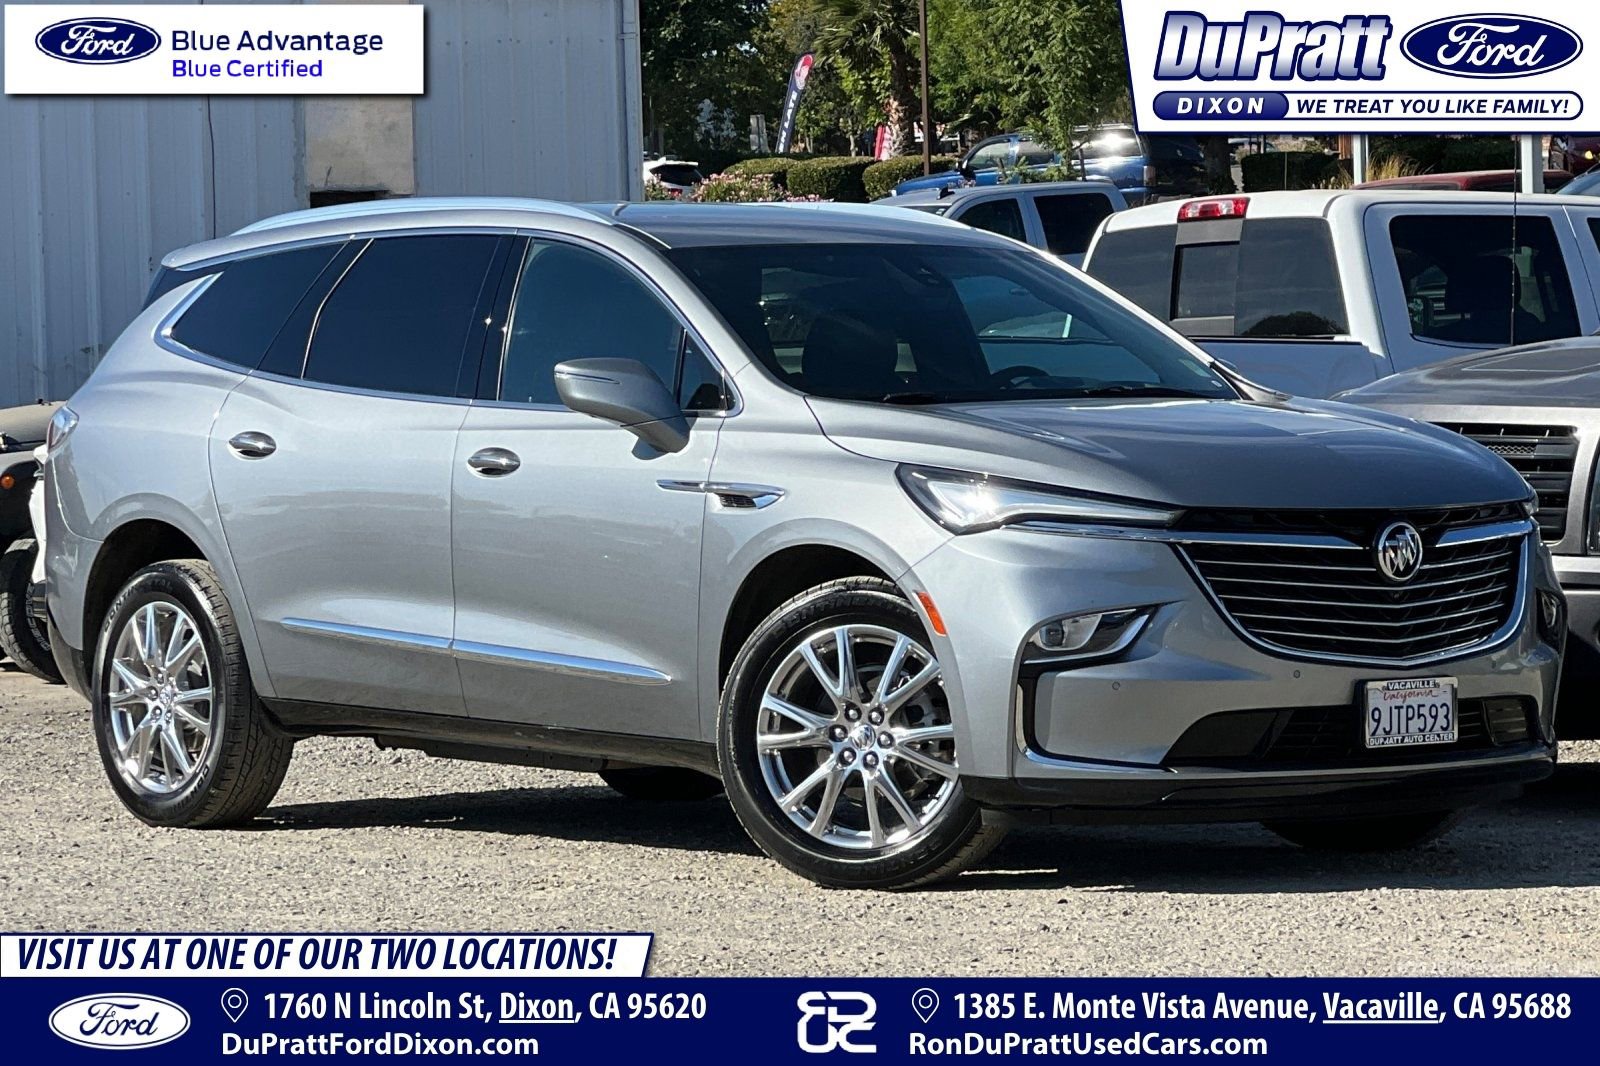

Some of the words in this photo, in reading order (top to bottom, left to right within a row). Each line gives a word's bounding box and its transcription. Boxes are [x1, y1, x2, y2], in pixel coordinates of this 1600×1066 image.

[1388, 680, 1436, 690] VACAVILLE
[1371, 702, 1450, 736] 9JTP593
[1403, 734, 1424, 743] AUTO
[1425, 732, 1454, 742] CENTER
